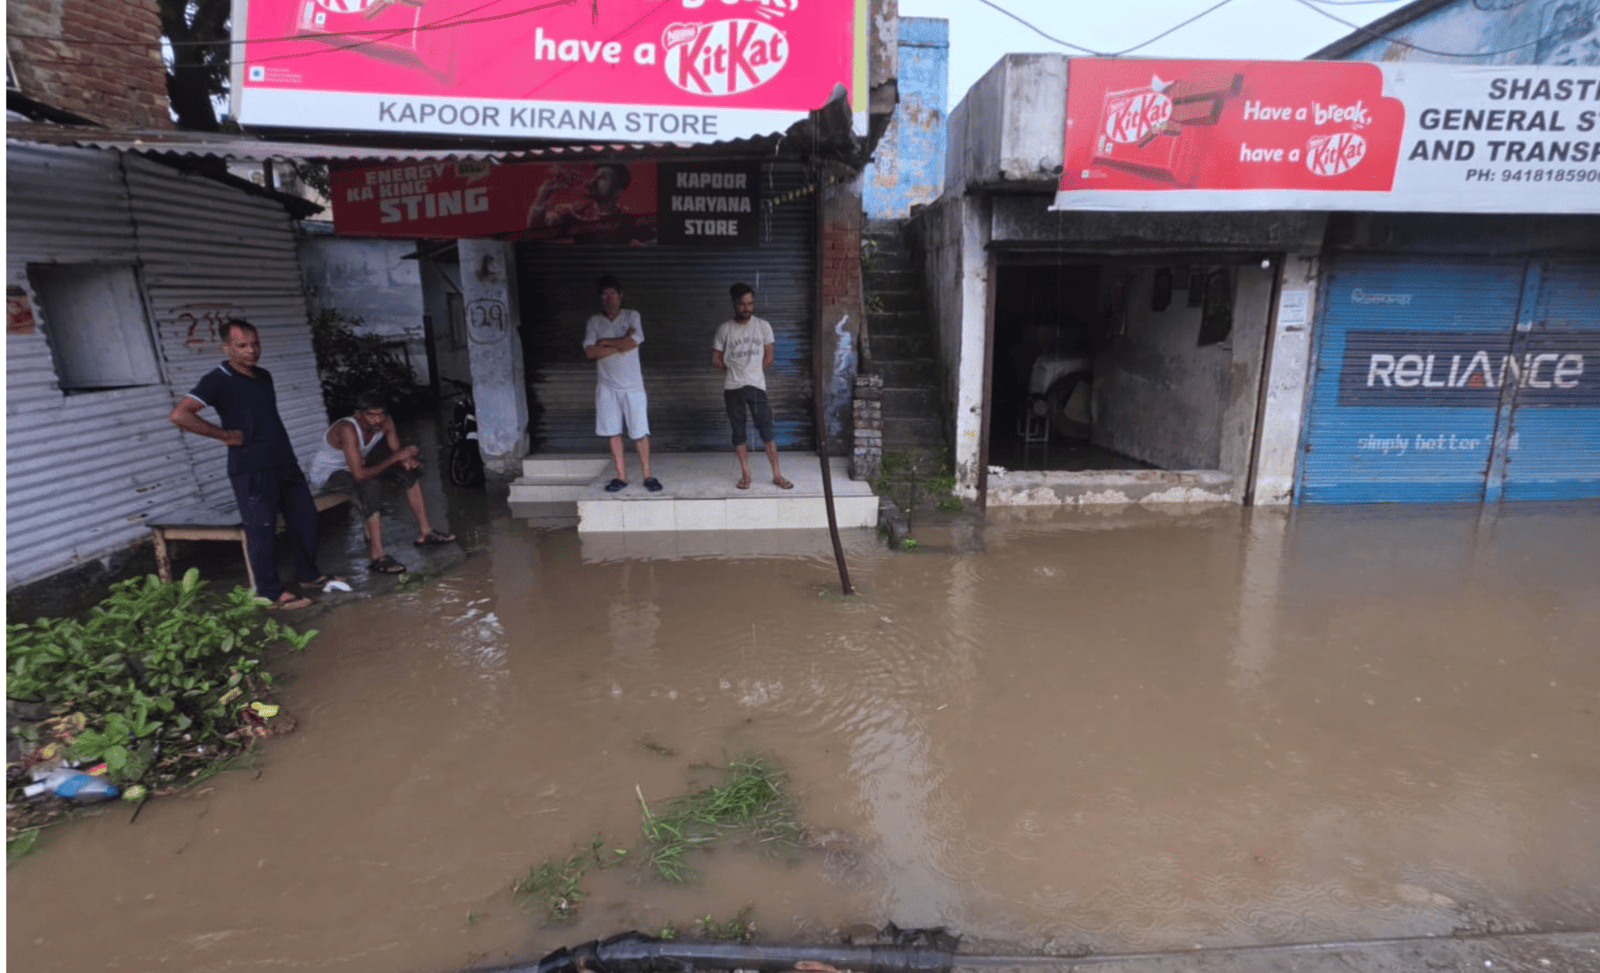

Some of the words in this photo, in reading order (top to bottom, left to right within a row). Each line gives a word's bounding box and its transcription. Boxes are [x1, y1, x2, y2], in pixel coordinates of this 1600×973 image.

[535, 27, 622, 63] have
[634, 42, 656, 65] a
[679, 20, 783, 93] KitKat
[1488, 78, 1600, 100] SHAST
[378, 101, 500, 127] KAPOOR
[509, 106, 617, 131] KIRANA
[625, 111, 718, 135] STORE
[1243, 100, 1292, 121] Have
[1295, 107, 1307, 121] a
[1312, 100, 1373, 126] break,
[1419, 108, 1566, 131] GENERAL
[1576, 110, 1600, 131] S
[1240, 142, 1284, 162] have
[1288, 149, 1300, 162] a
[1311, 135, 1363, 174] KitKat
[1408, 139, 1475, 161] AND
[365, 163, 445, 185] ENERGY
[676, 172, 747, 189] KAPOOR
[1465, 168, 1496, 181] PH:
[379, 179, 428, 199] KING
[379, 186, 489, 223] STING
[671, 195, 751, 213] KARYANA
[684, 219, 738, 236] STORE
